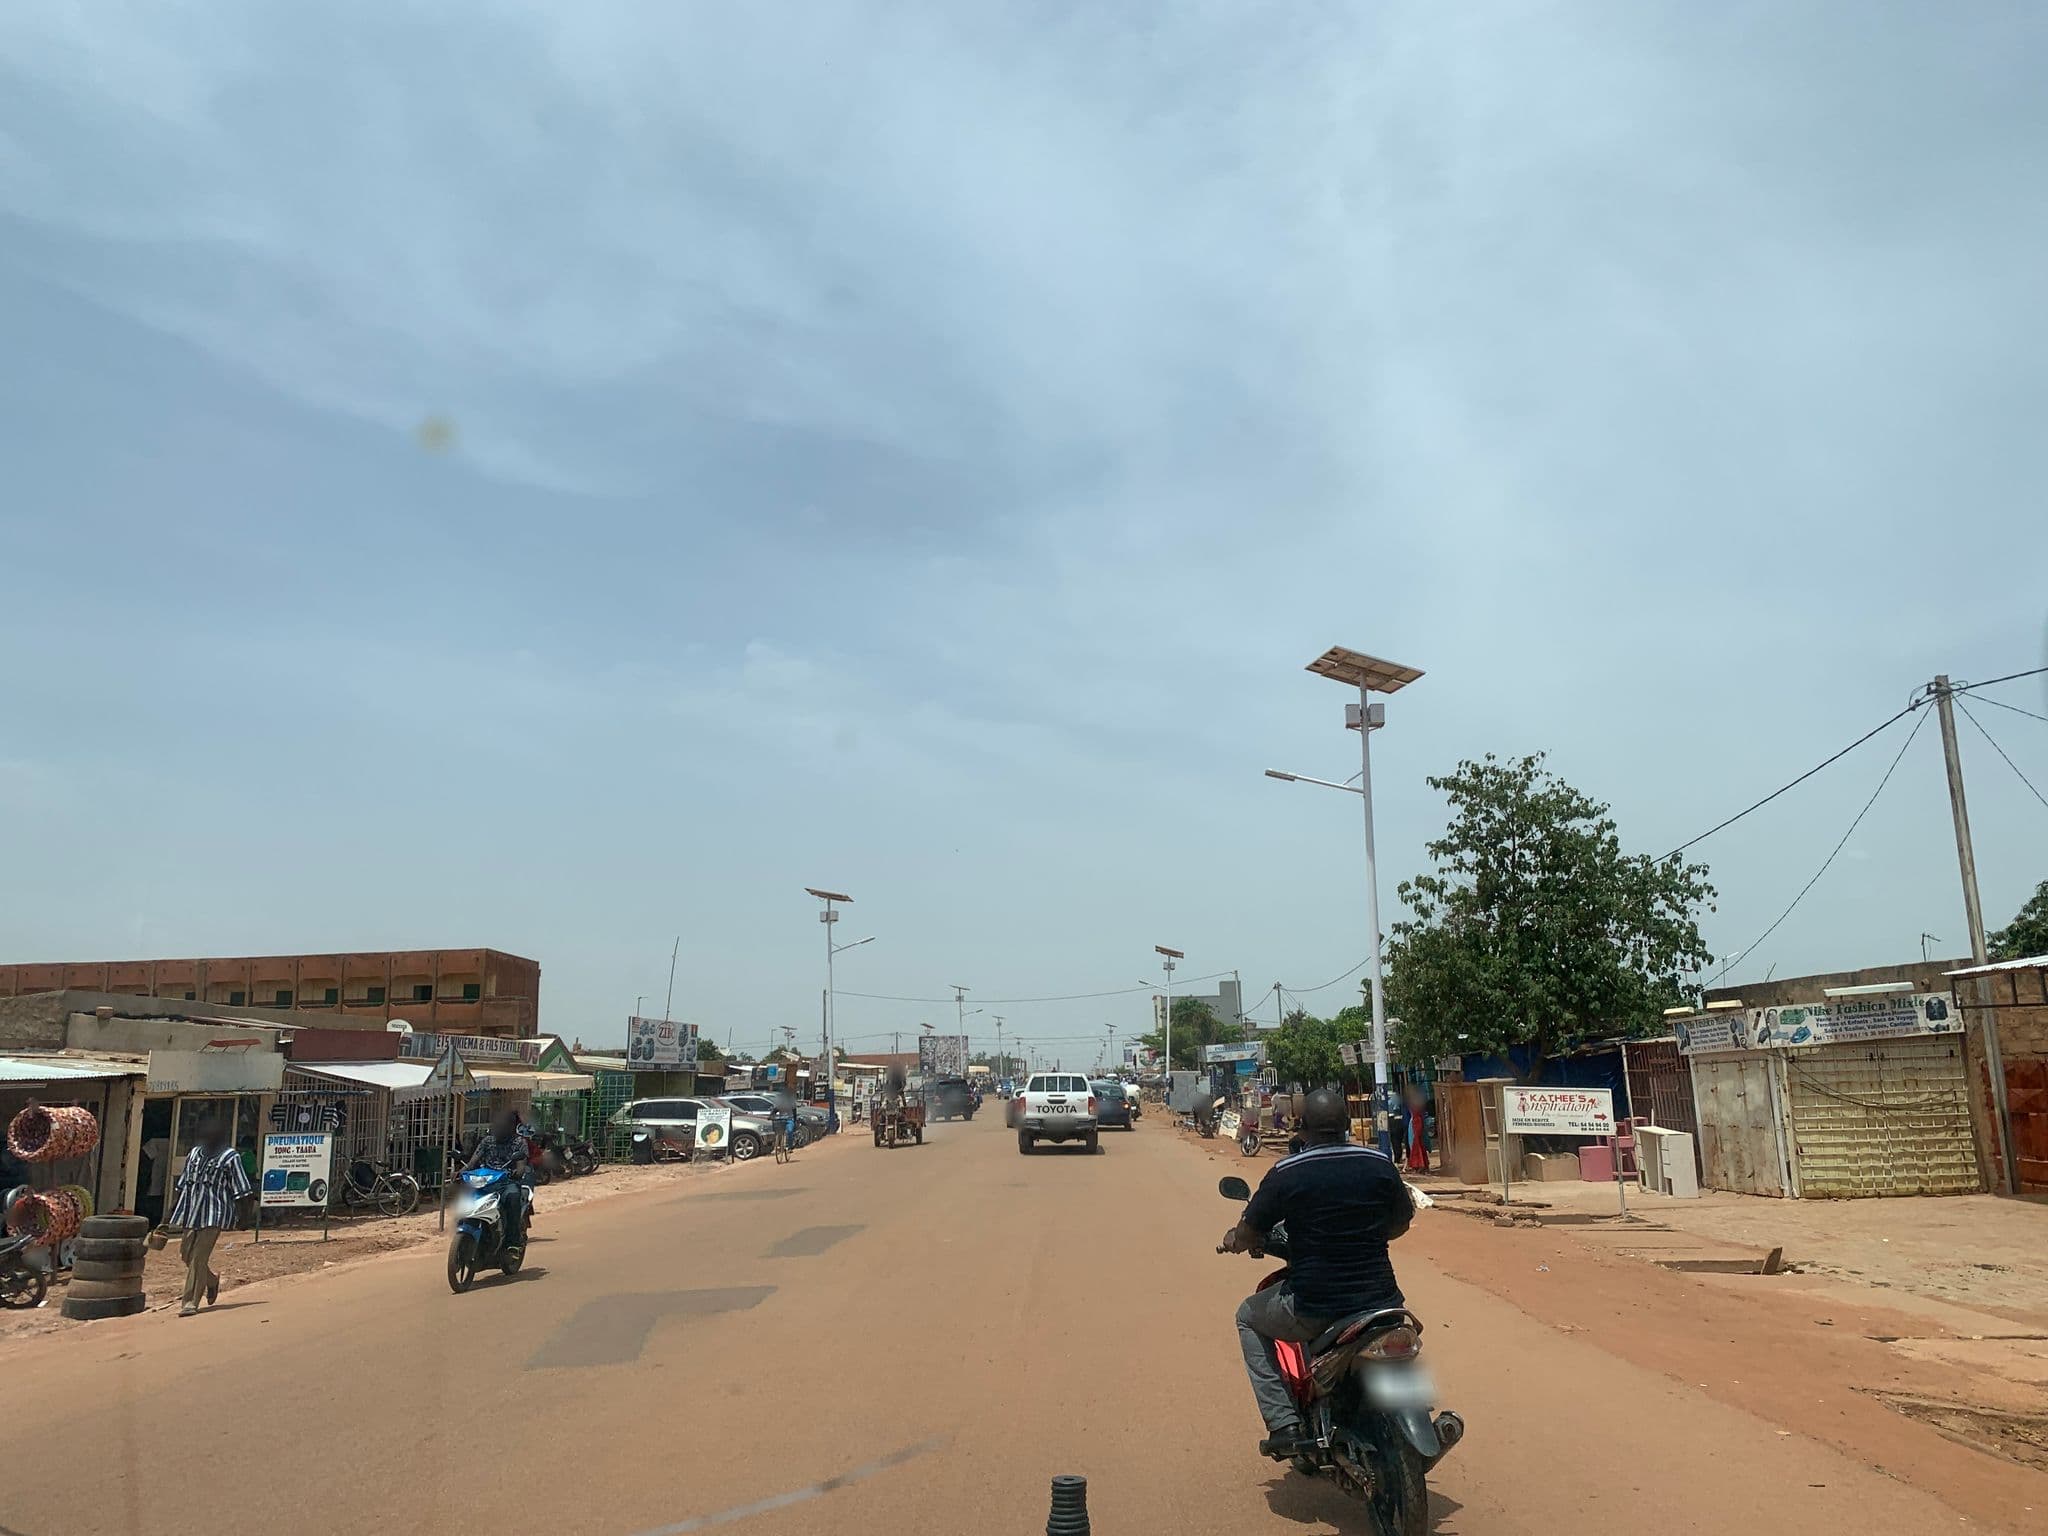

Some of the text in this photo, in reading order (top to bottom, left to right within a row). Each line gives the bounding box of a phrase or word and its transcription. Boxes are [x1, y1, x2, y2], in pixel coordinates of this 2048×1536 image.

[1836, 1002, 1886, 1015] Fashion
[479, 1039, 485, 1051] &
[486, 1039, 499, 1051] FILS
[1529, 1094, 1587, 1103] KATHEE'S
[1036, 1105, 1077, 1113] TOYOTA
[268, 1135, 325, 1147] PNEUMATIQUE
